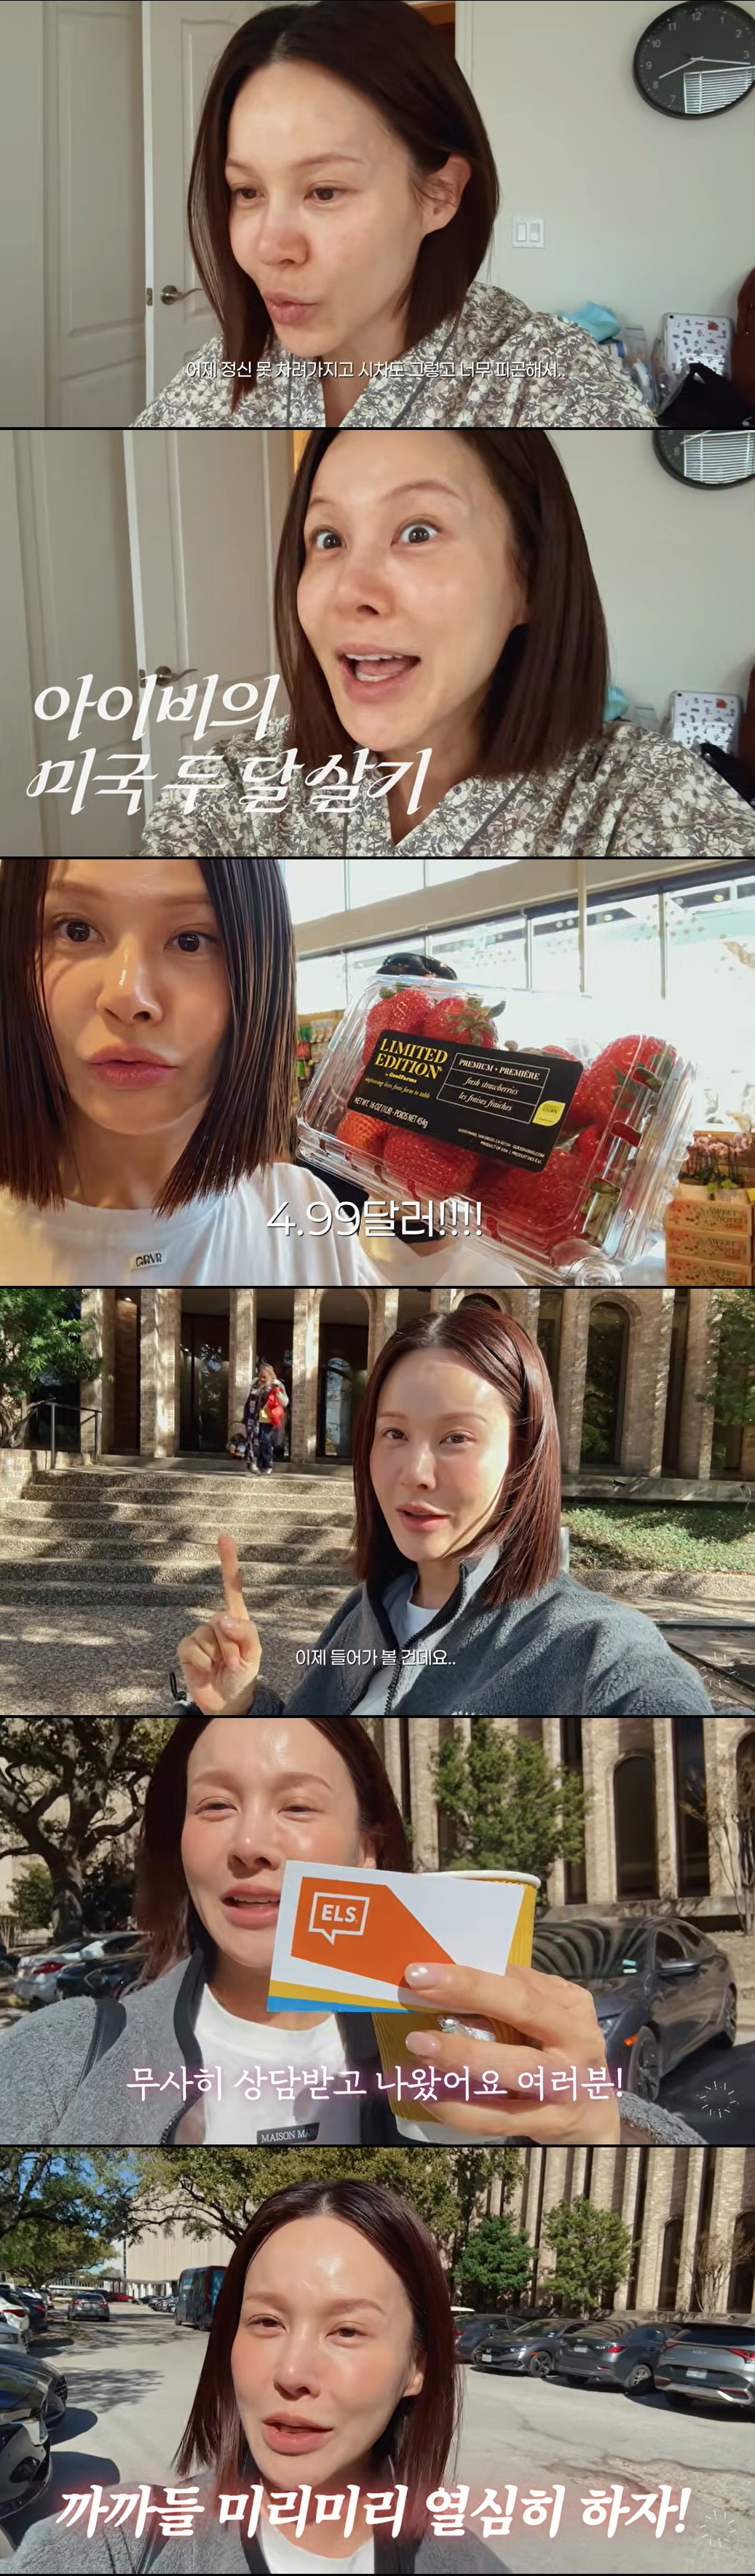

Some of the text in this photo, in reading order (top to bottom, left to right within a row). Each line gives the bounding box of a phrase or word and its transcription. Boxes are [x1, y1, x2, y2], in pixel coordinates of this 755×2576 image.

[692, 12, 701, 21] 12
[720, 16, 724, 24] 1
[668, 23, 677, 31] 11
[735, 29, 742, 38] 2
[652, 39, 661, 48] 10
[743, 50, 750, 60] 3
[646, 61, 652, 70] 9
[653, 80, 658, 89] 8
[671, 95, 676, 103] 7
[379, 1038, 448, 1064] LIMITED
[375, 1053, 441, 1079] EDITION
[459, 1059, 494, 1072] PREMIUM
[462, 1077, 519, 1095] fresh strawberries
[458, 1092, 468, 1100] les
[465, 1094, 487, 1105] fraises
[354, 1097, 363, 1105] NET
[369, 1100, 375, 1109] 16
[374, 1102, 382, 1111] OZ
[394, 1110, 408, 1121] POIDS
[407, 1113, 418, 1124] NET
[416, 1117, 429, 1129] 454g
[481, 1140, 496, 1149] PRODUCT
[511, 1150, 527, 1160] PRODUIT
[321, 1904, 357, 1923] ELS
[261, 2128, 313, 2143] MAISON MA
